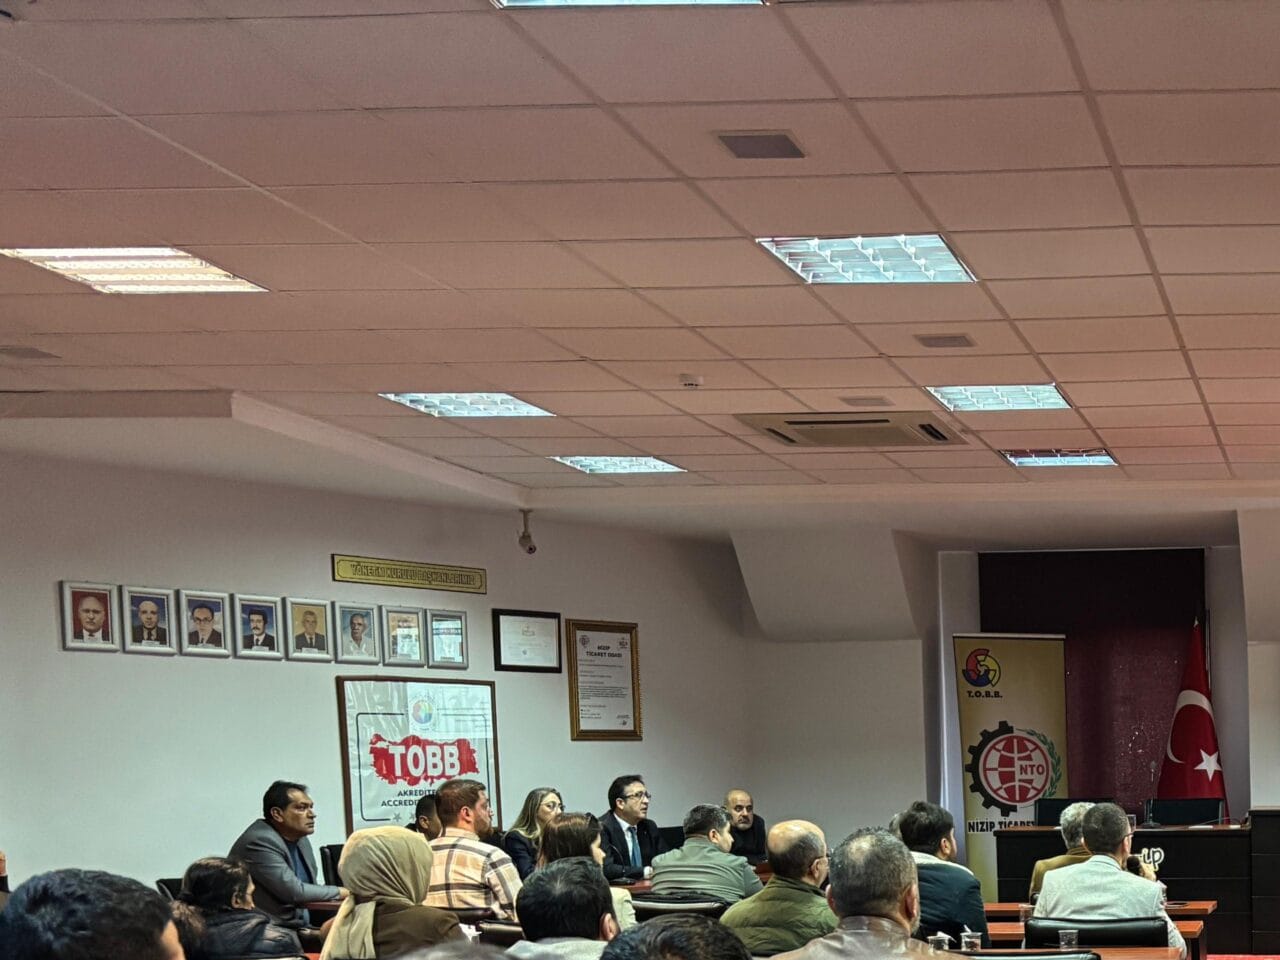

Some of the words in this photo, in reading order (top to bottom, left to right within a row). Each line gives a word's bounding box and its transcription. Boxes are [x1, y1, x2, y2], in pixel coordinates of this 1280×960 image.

[967, 690, 1003, 698] T.O.B.B.
[388, 745, 461, 777] TOBB
[1019, 764, 1045, 775] NTO
[381, 799, 417, 807] ACCREDI
